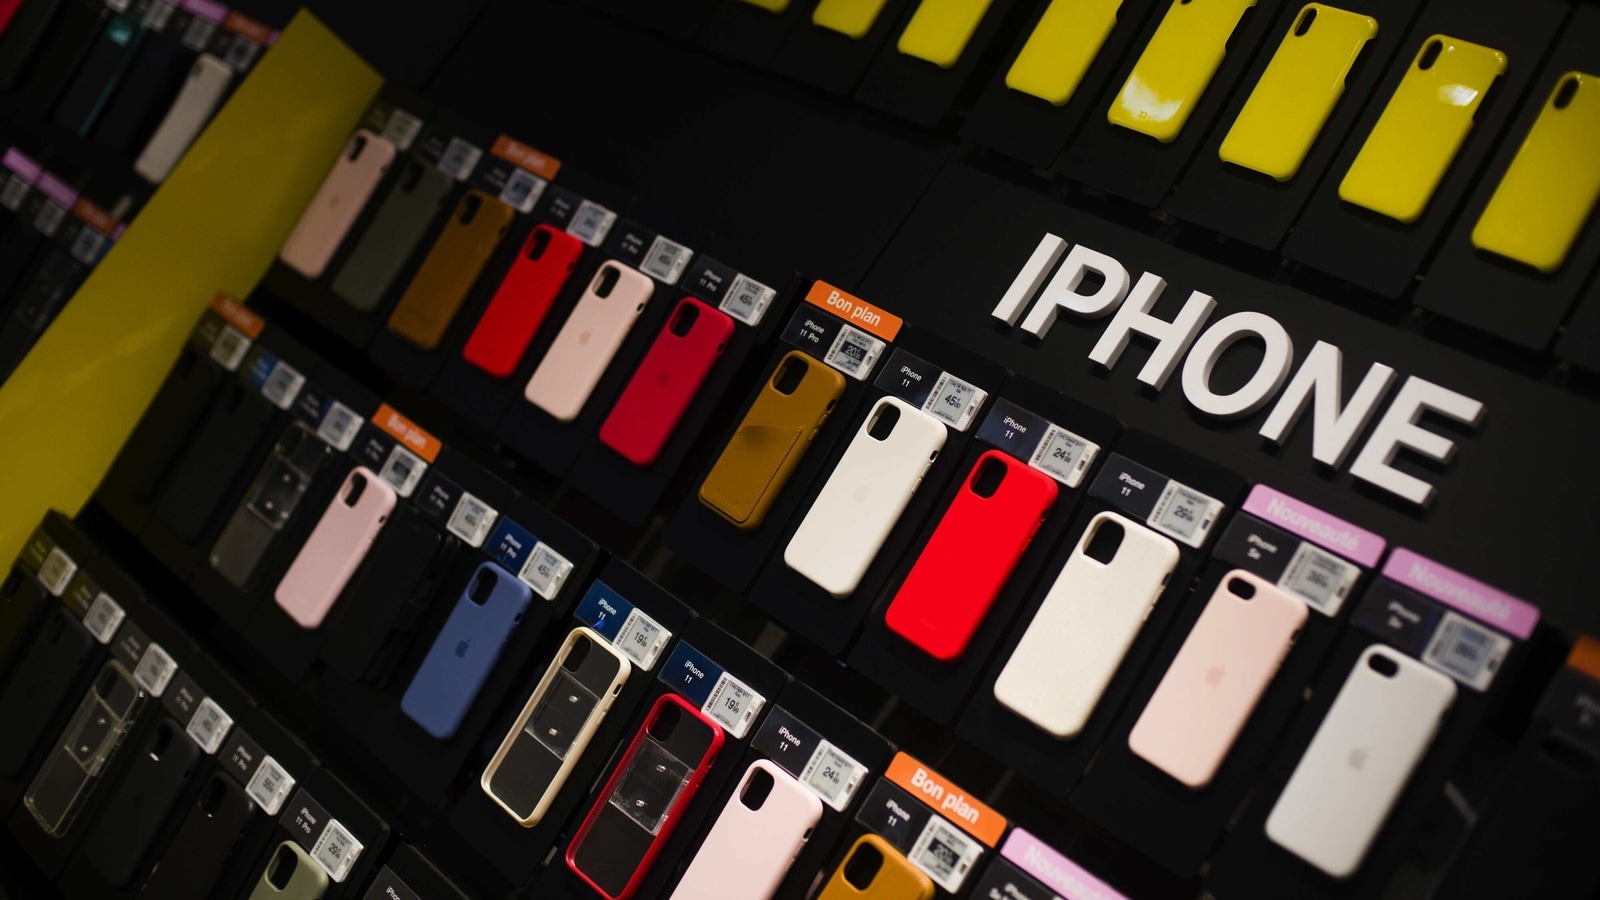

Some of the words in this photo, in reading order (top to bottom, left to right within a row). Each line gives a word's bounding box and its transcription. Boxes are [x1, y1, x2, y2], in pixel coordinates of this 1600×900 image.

[704, 270, 722, 282] iPhone
[707, 282, 716, 291] Pro
[827, 291, 852, 312] Bon
[851, 306, 880, 326] plan
[805, 320, 824, 334] iPhone
[808, 333, 819, 342] Pro
[901, 366, 922, 381] iPhone
[991, 232, 1487, 506] IPHONE
[902, 379, 910, 387] 11
[388, 414, 406, 433] Bon
[402, 426, 426, 447] plan
[1004, 416, 1026, 433] iPhone
[1005, 430, 1014, 438] 11
[1119, 472, 1145, 489] iPhone
[1122, 487, 1131, 496] 11
[1266, 498, 1360, 551] Nouveauté
[505, 534, 522, 549] iPhone
[1248, 534, 1277, 552] iPhone
[507, 548, 516, 558] Pro
[1408, 562, 1511, 620] Nouveauté
[598, 598, 616, 615] iPhone
[599, 612, 606, 620] 11
[684, 660, 704, 678] iPhone
[685, 675, 692, 683] 11
[778, 726, 800, 746] iPhone
[238, 746, 251, 761] iPhone
[780, 742, 788, 751] 11
[911, 768, 944, 800] Bon
[942, 794, 979, 824] plan
[301, 808, 316, 824] iPhone
[886, 800, 910, 821] iPhone
[296, 816, 302, 824] 11
[302, 822, 310, 833] Pro
[888, 816, 897, 826] 11
